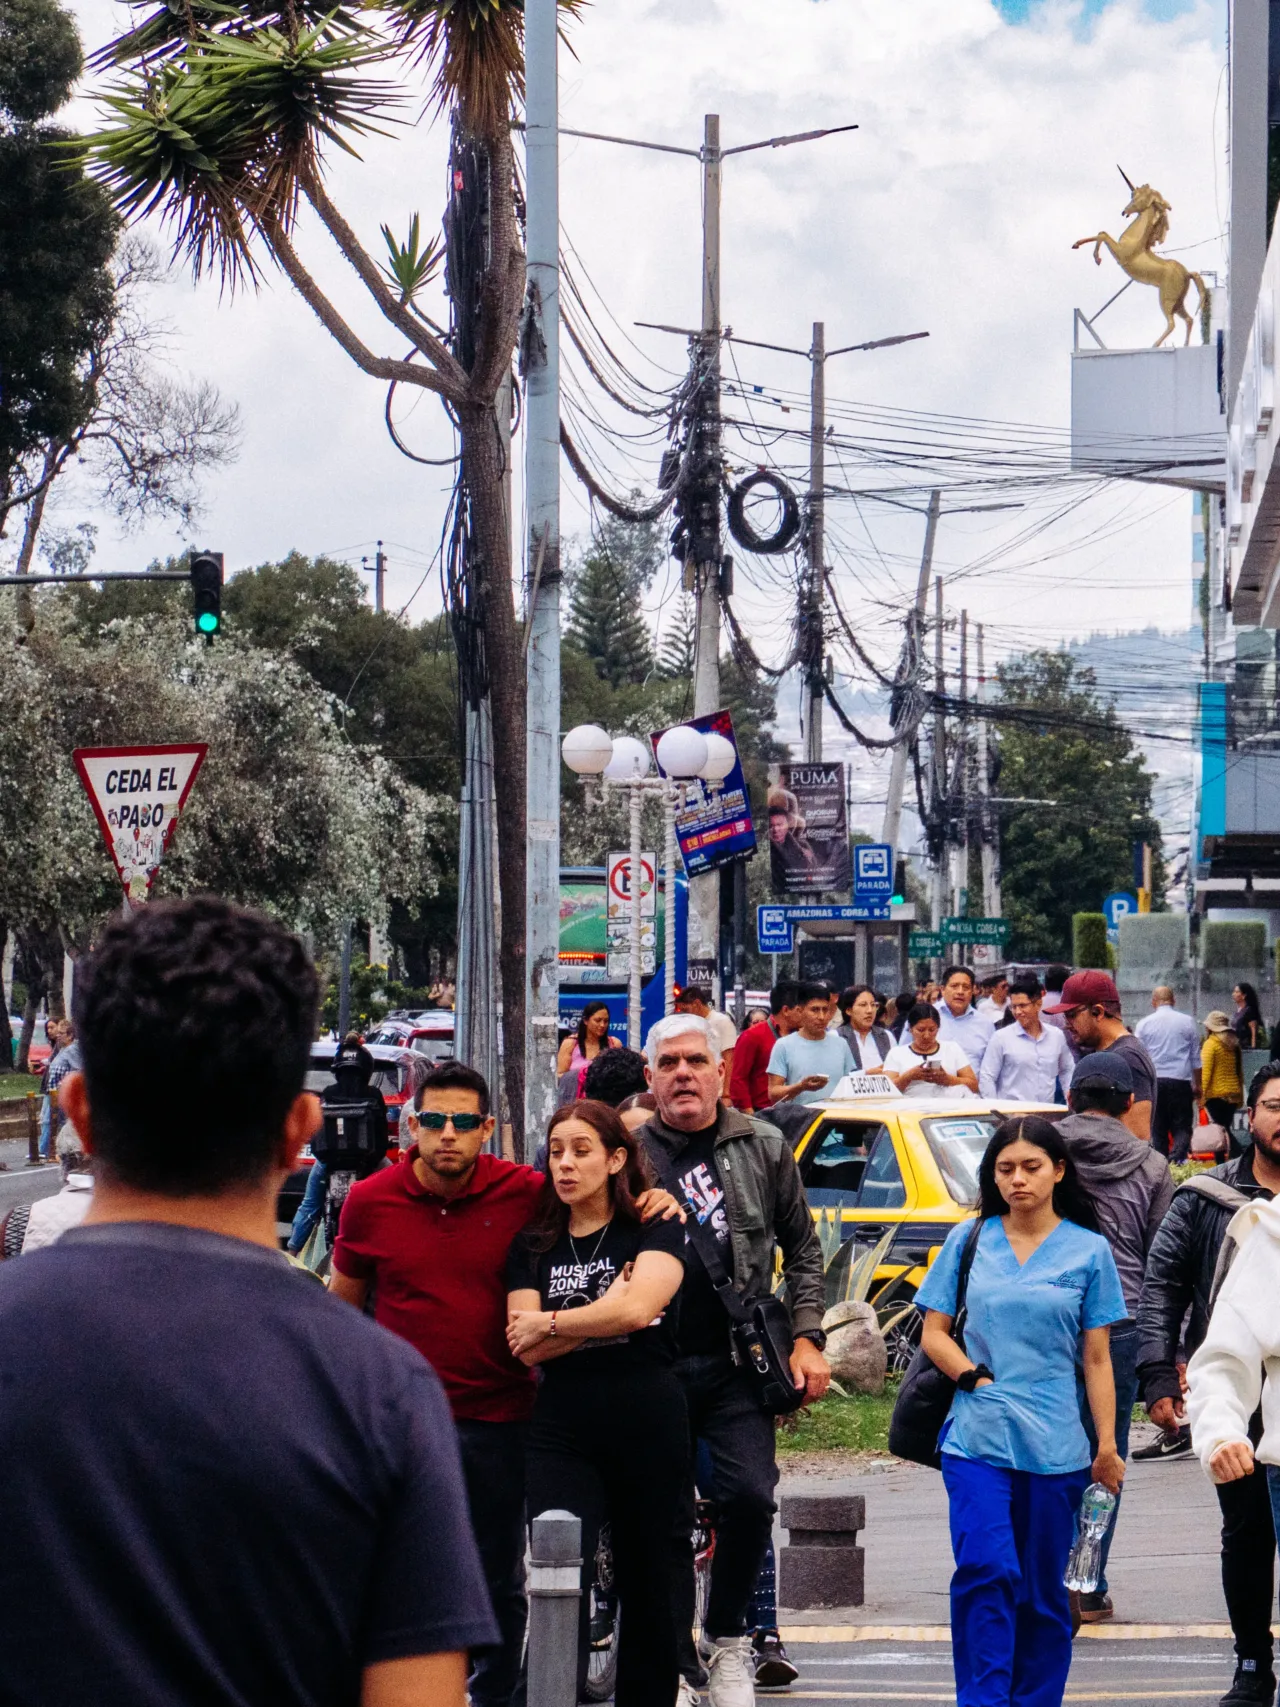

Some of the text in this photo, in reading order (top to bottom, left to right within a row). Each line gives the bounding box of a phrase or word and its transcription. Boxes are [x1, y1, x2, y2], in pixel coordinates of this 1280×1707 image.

[105, 767, 178, 794] CEDA EL
[790, 770, 839, 785] PUMA
[857, 881, 890, 890] PARADA
[786, 908, 833, 918] AMAZONAS
[841, 908, 869, 917] COREA
[761, 938, 790, 947] PARADA
[850, 1076, 891, 1094] EJECUTIVO
[550, 1256, 616, 1279] MUSICAL
[548, 1276, 590, 1294] ZONE
